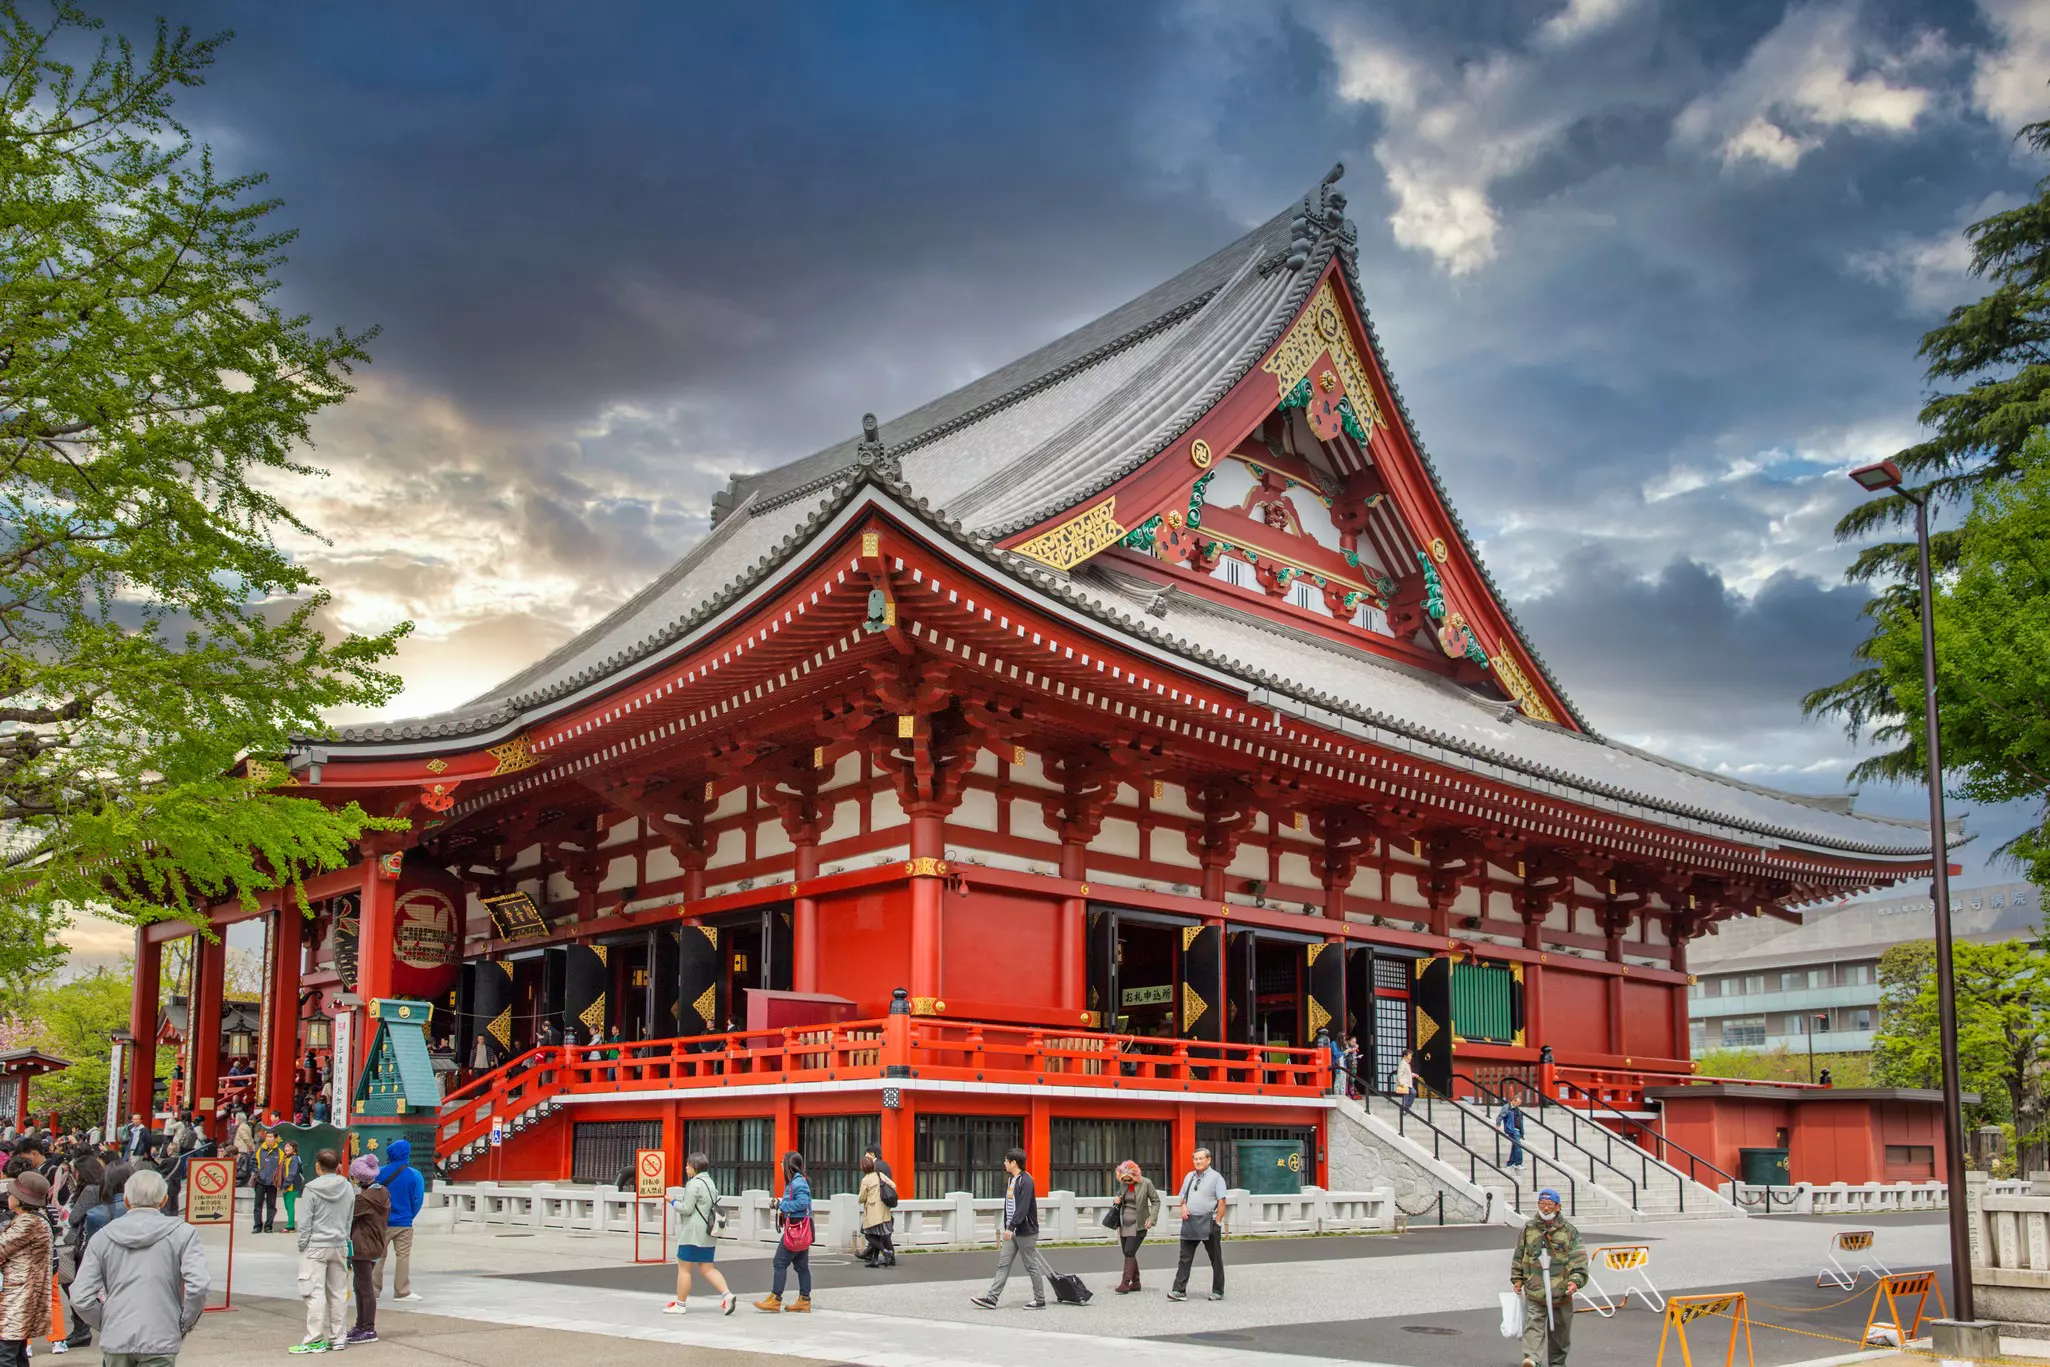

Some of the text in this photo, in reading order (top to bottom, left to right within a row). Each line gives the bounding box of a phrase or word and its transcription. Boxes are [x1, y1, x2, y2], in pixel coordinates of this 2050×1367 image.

[1929, 891, 2027, 915] 草寺病院
[1125, 988, 1171, 1003] お札申込所
